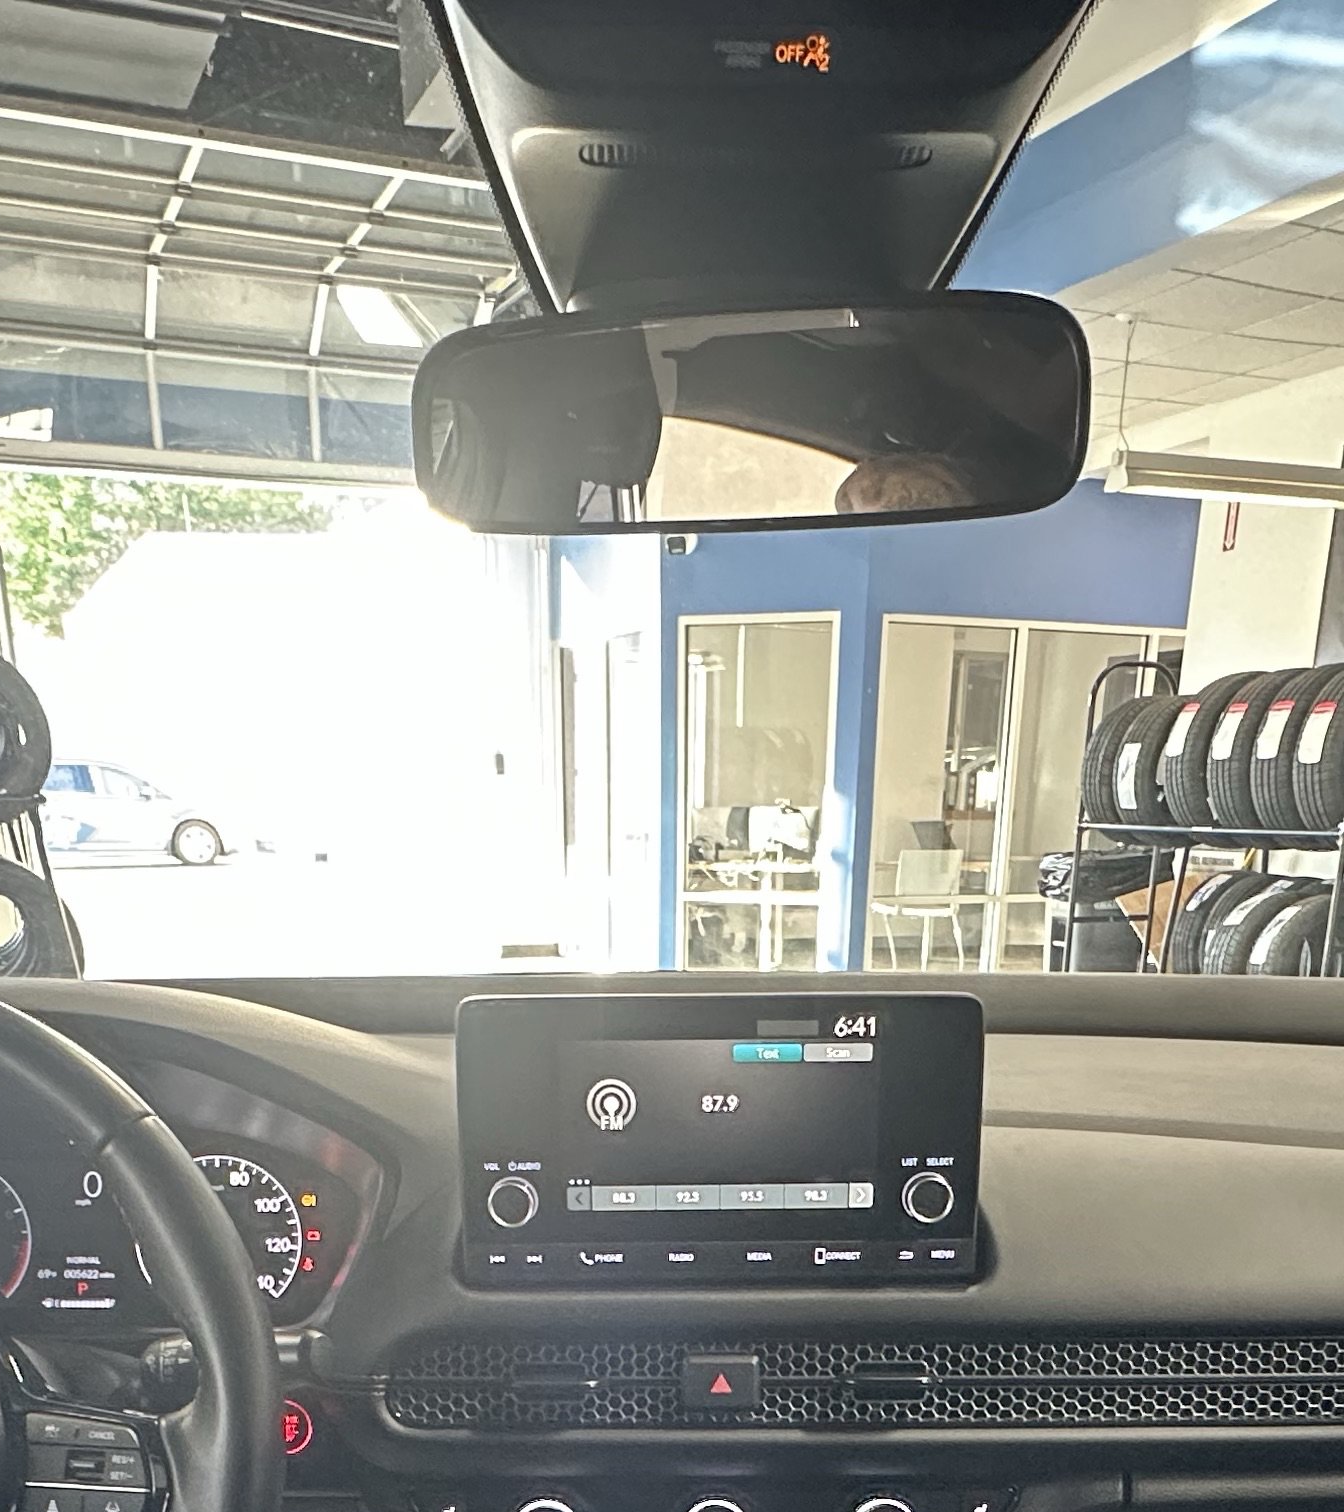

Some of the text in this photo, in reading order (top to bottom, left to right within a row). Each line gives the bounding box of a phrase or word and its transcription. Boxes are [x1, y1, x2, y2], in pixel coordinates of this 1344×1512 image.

[775, 45, 805, 64] OFF
[832, 1016, 876, 1038] 6:41
[826, 1047, 851, 1058] Scan
[701, 1094, 739, 1113] 87.9
[600, 1115, 624, 1131] FM
[83, 1170, 103, 1198] 0
[254, 1197, 281, 1213] 100
[265, 1237, 291, 1253] 120
[77, 1281, 88, 1296] P
